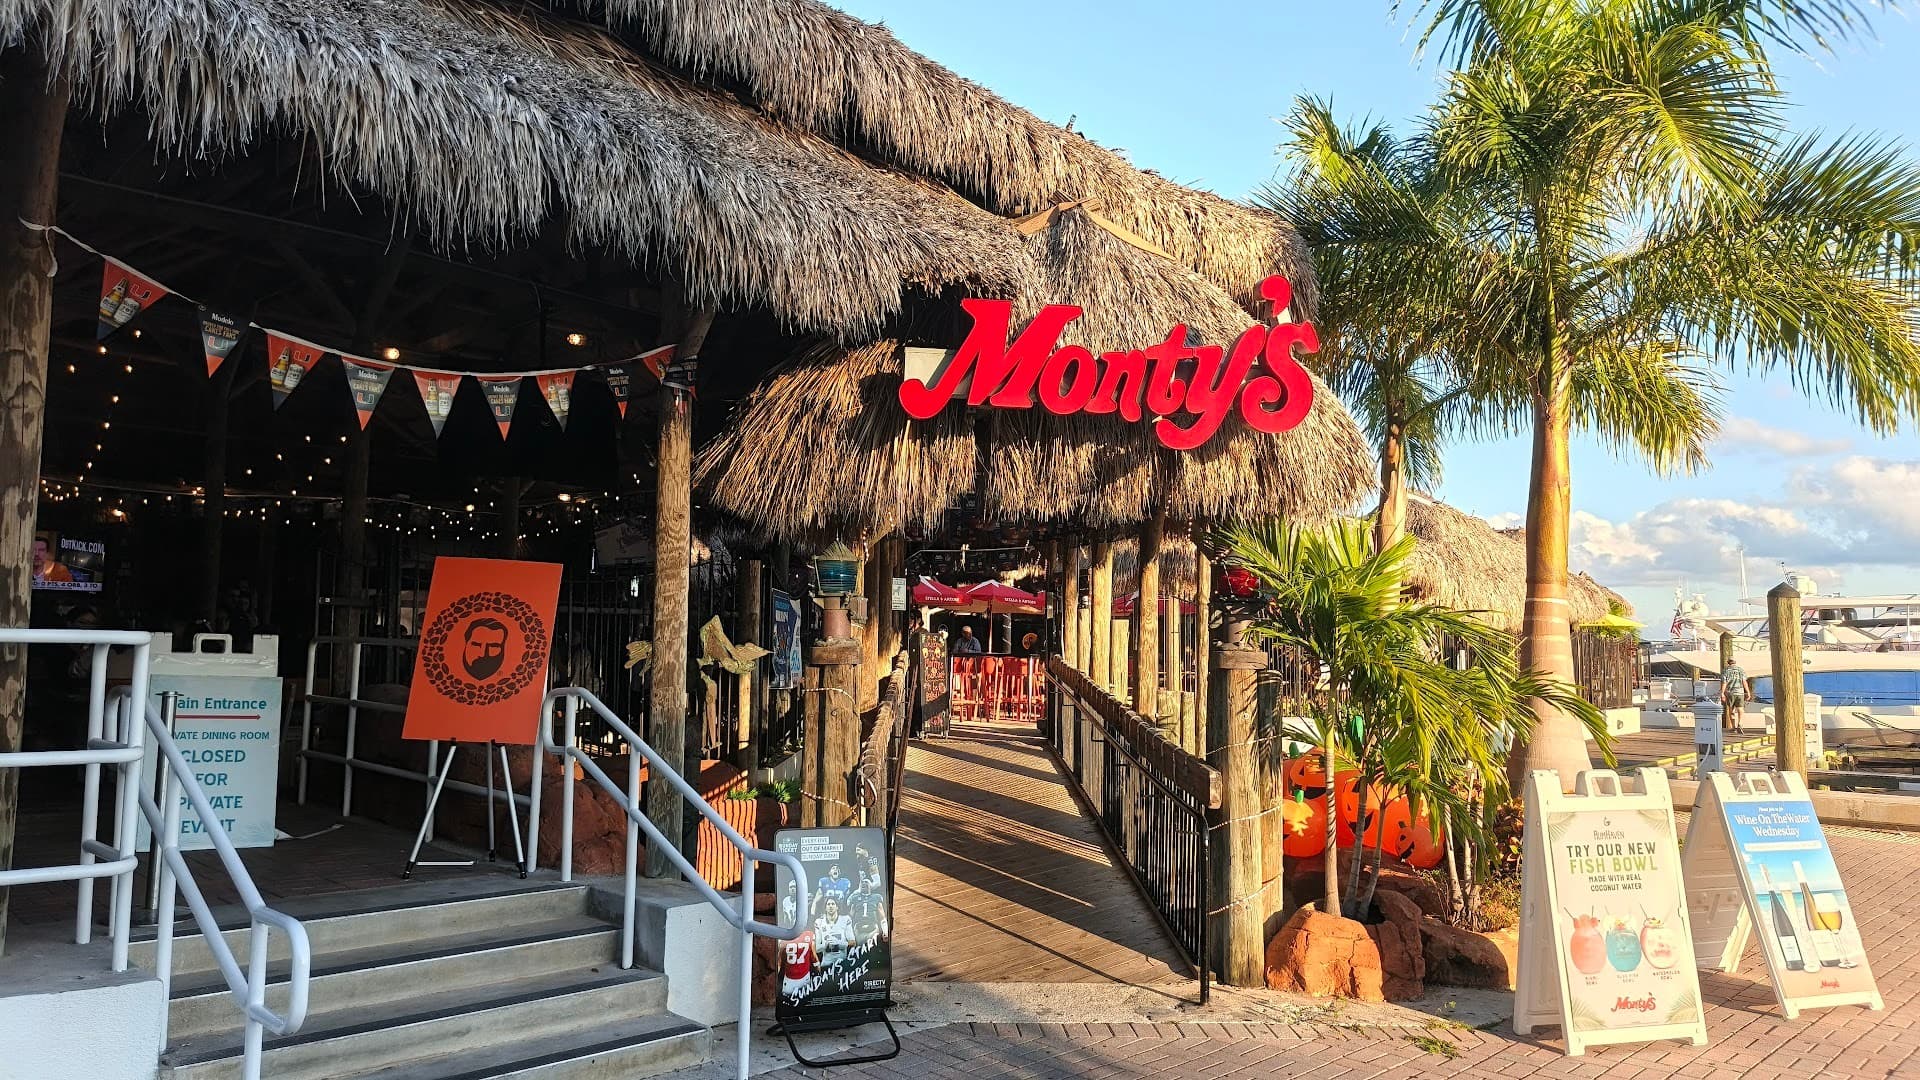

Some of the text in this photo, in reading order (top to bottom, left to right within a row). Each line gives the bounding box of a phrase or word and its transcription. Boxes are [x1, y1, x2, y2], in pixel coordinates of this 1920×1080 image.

[211, 312, 234, 326] Modelo
[358, 369, 378, 380] Modelo
[177, 697, 267, 710] ain Entrance
[174, 731, 270, 740] VATE DINING ROOM
[181, 750, 246, 763] CLOSED
[195, 773, 228, 786] FOR
[180, 795, 243, 810] PATE
[181, 818, 236, 833] EVT
[1734, 814, 1758, 825] Wine
[1757, 813, 1771, 824] On
[1752, 825, 1800, 838] Wednesday
[1566, 842, 1656, 858] TRY OUR NEW
[1569, 855, 1659, 874] FISH BOWL
[1607, 874, 1625, 882] WITH
[1626, 873, 1642, 881] REAL
[1590, 882, 1642, 892] COCONUT WATER
[785, 942, 809, 965] 87
[790, 932, 880, 1007] SUNDAYS START
[839, 959, 869, 993] HERE
[863, 979, 886, 988] DIRECTV
